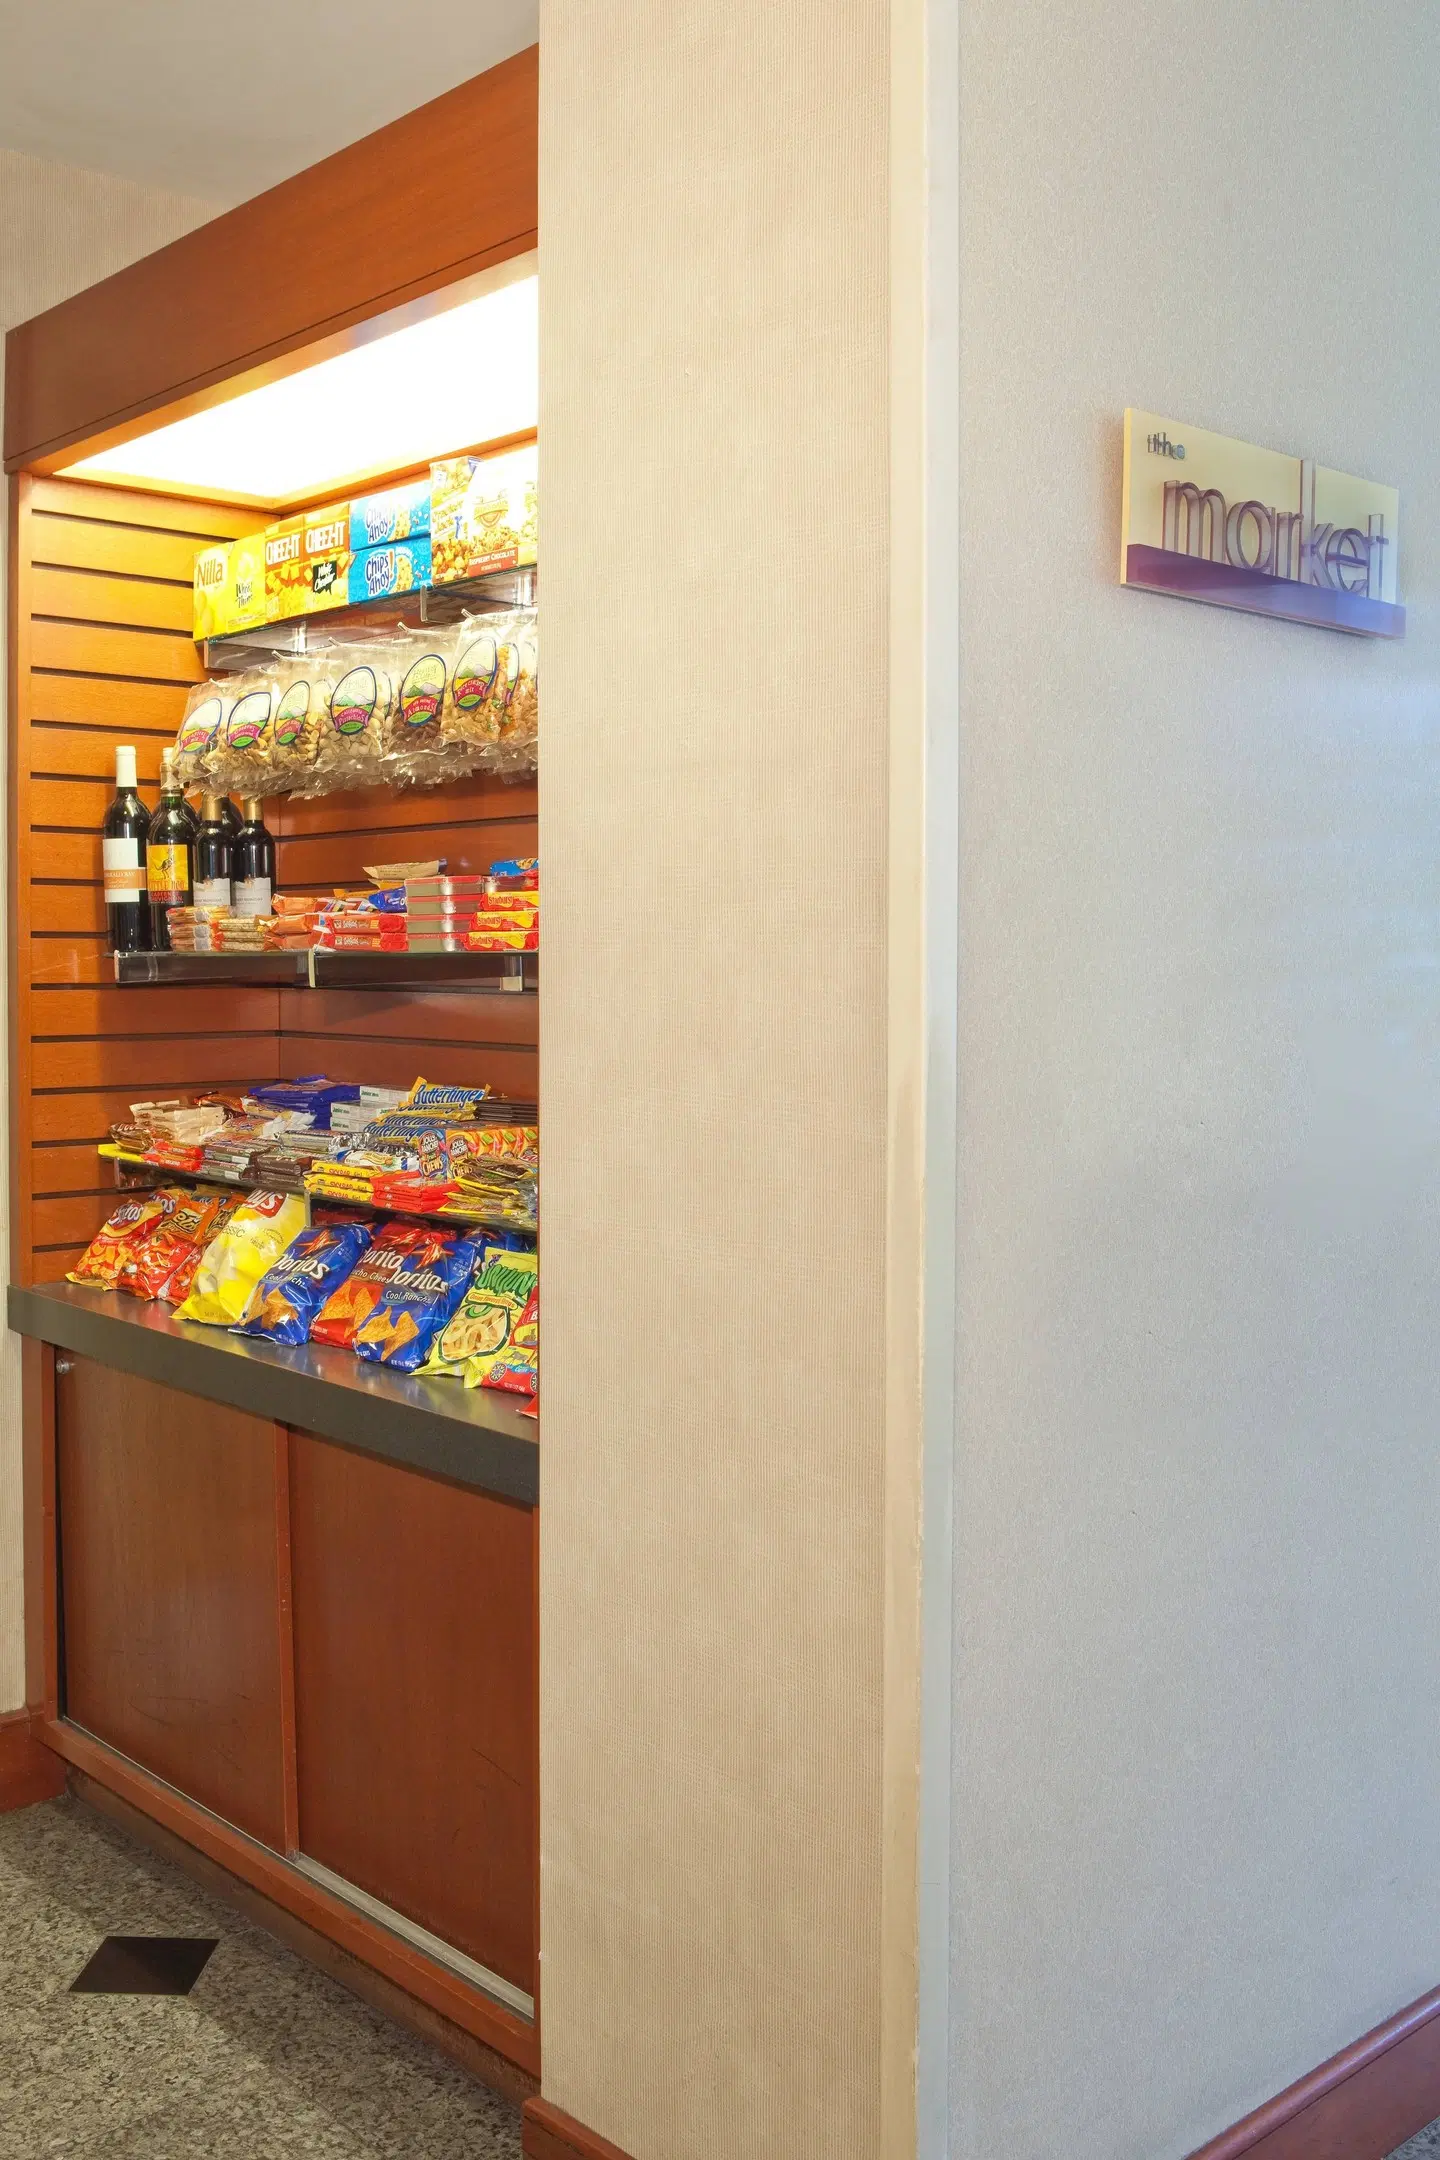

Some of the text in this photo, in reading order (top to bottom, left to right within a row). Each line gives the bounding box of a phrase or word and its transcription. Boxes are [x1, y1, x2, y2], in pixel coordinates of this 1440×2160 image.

[1147, 432, 1186, 460] the
[1162, 459, 1389, 601] market
[197, 559, 223, 588] Nilla
[366, 555, 388, 581] Chips
[385, 1290, 402, 1300] Cool
